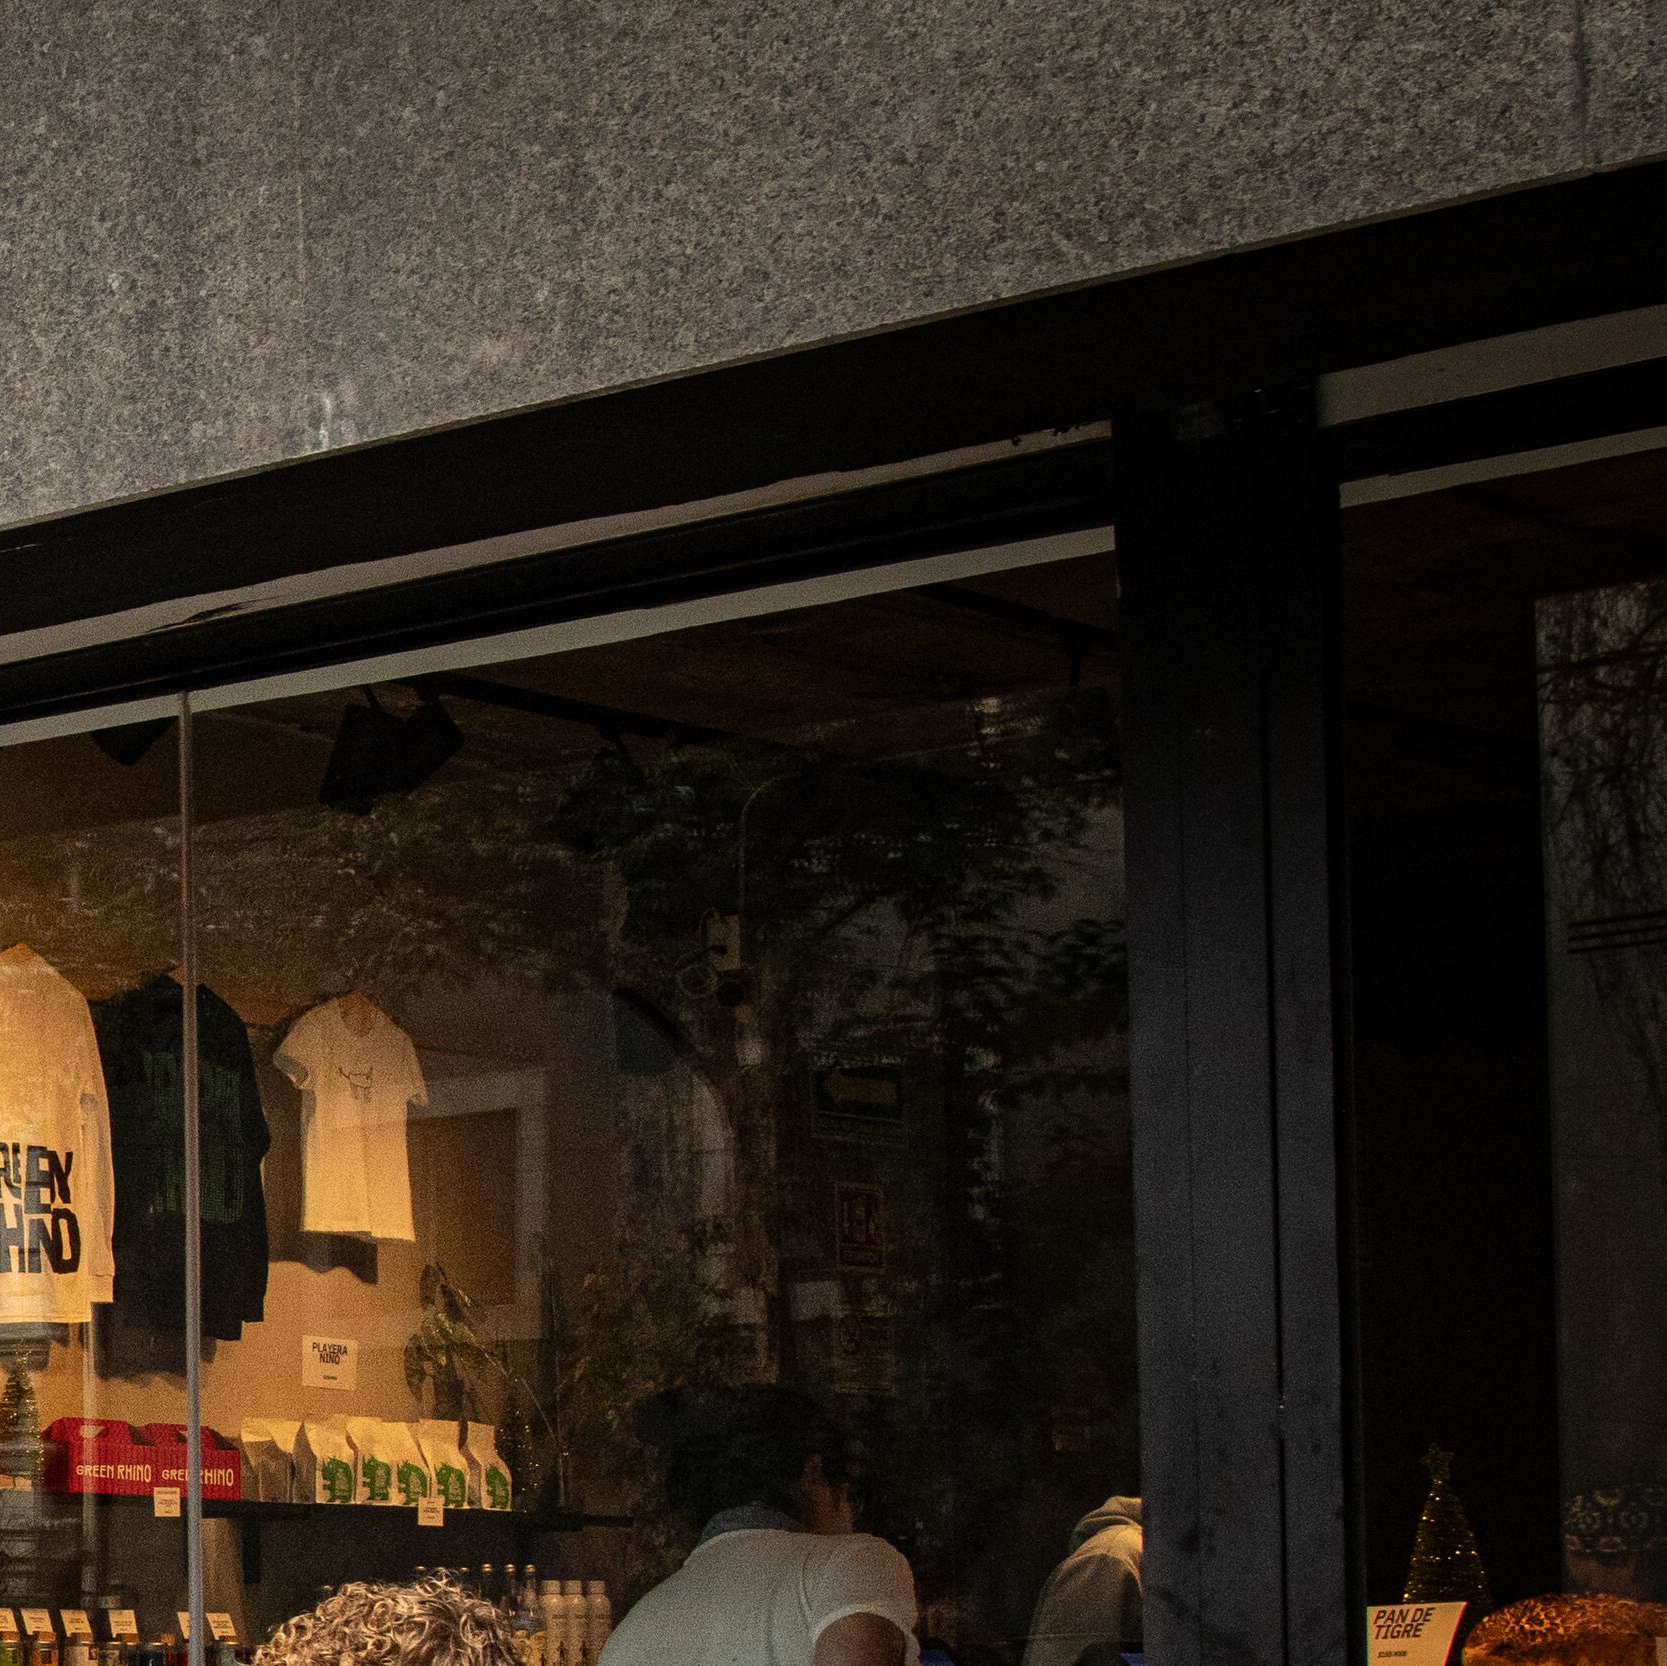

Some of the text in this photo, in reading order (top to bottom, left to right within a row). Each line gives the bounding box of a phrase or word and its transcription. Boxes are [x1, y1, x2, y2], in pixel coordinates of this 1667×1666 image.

[311, 1342, 348, 1356] PLAYERA
[75, 1463, 152, 1483] GREEN RHINO
[1373, 1606, 1436, 1625] PAN DE
[1374, 1622, 1426, 1640] TIGRE
